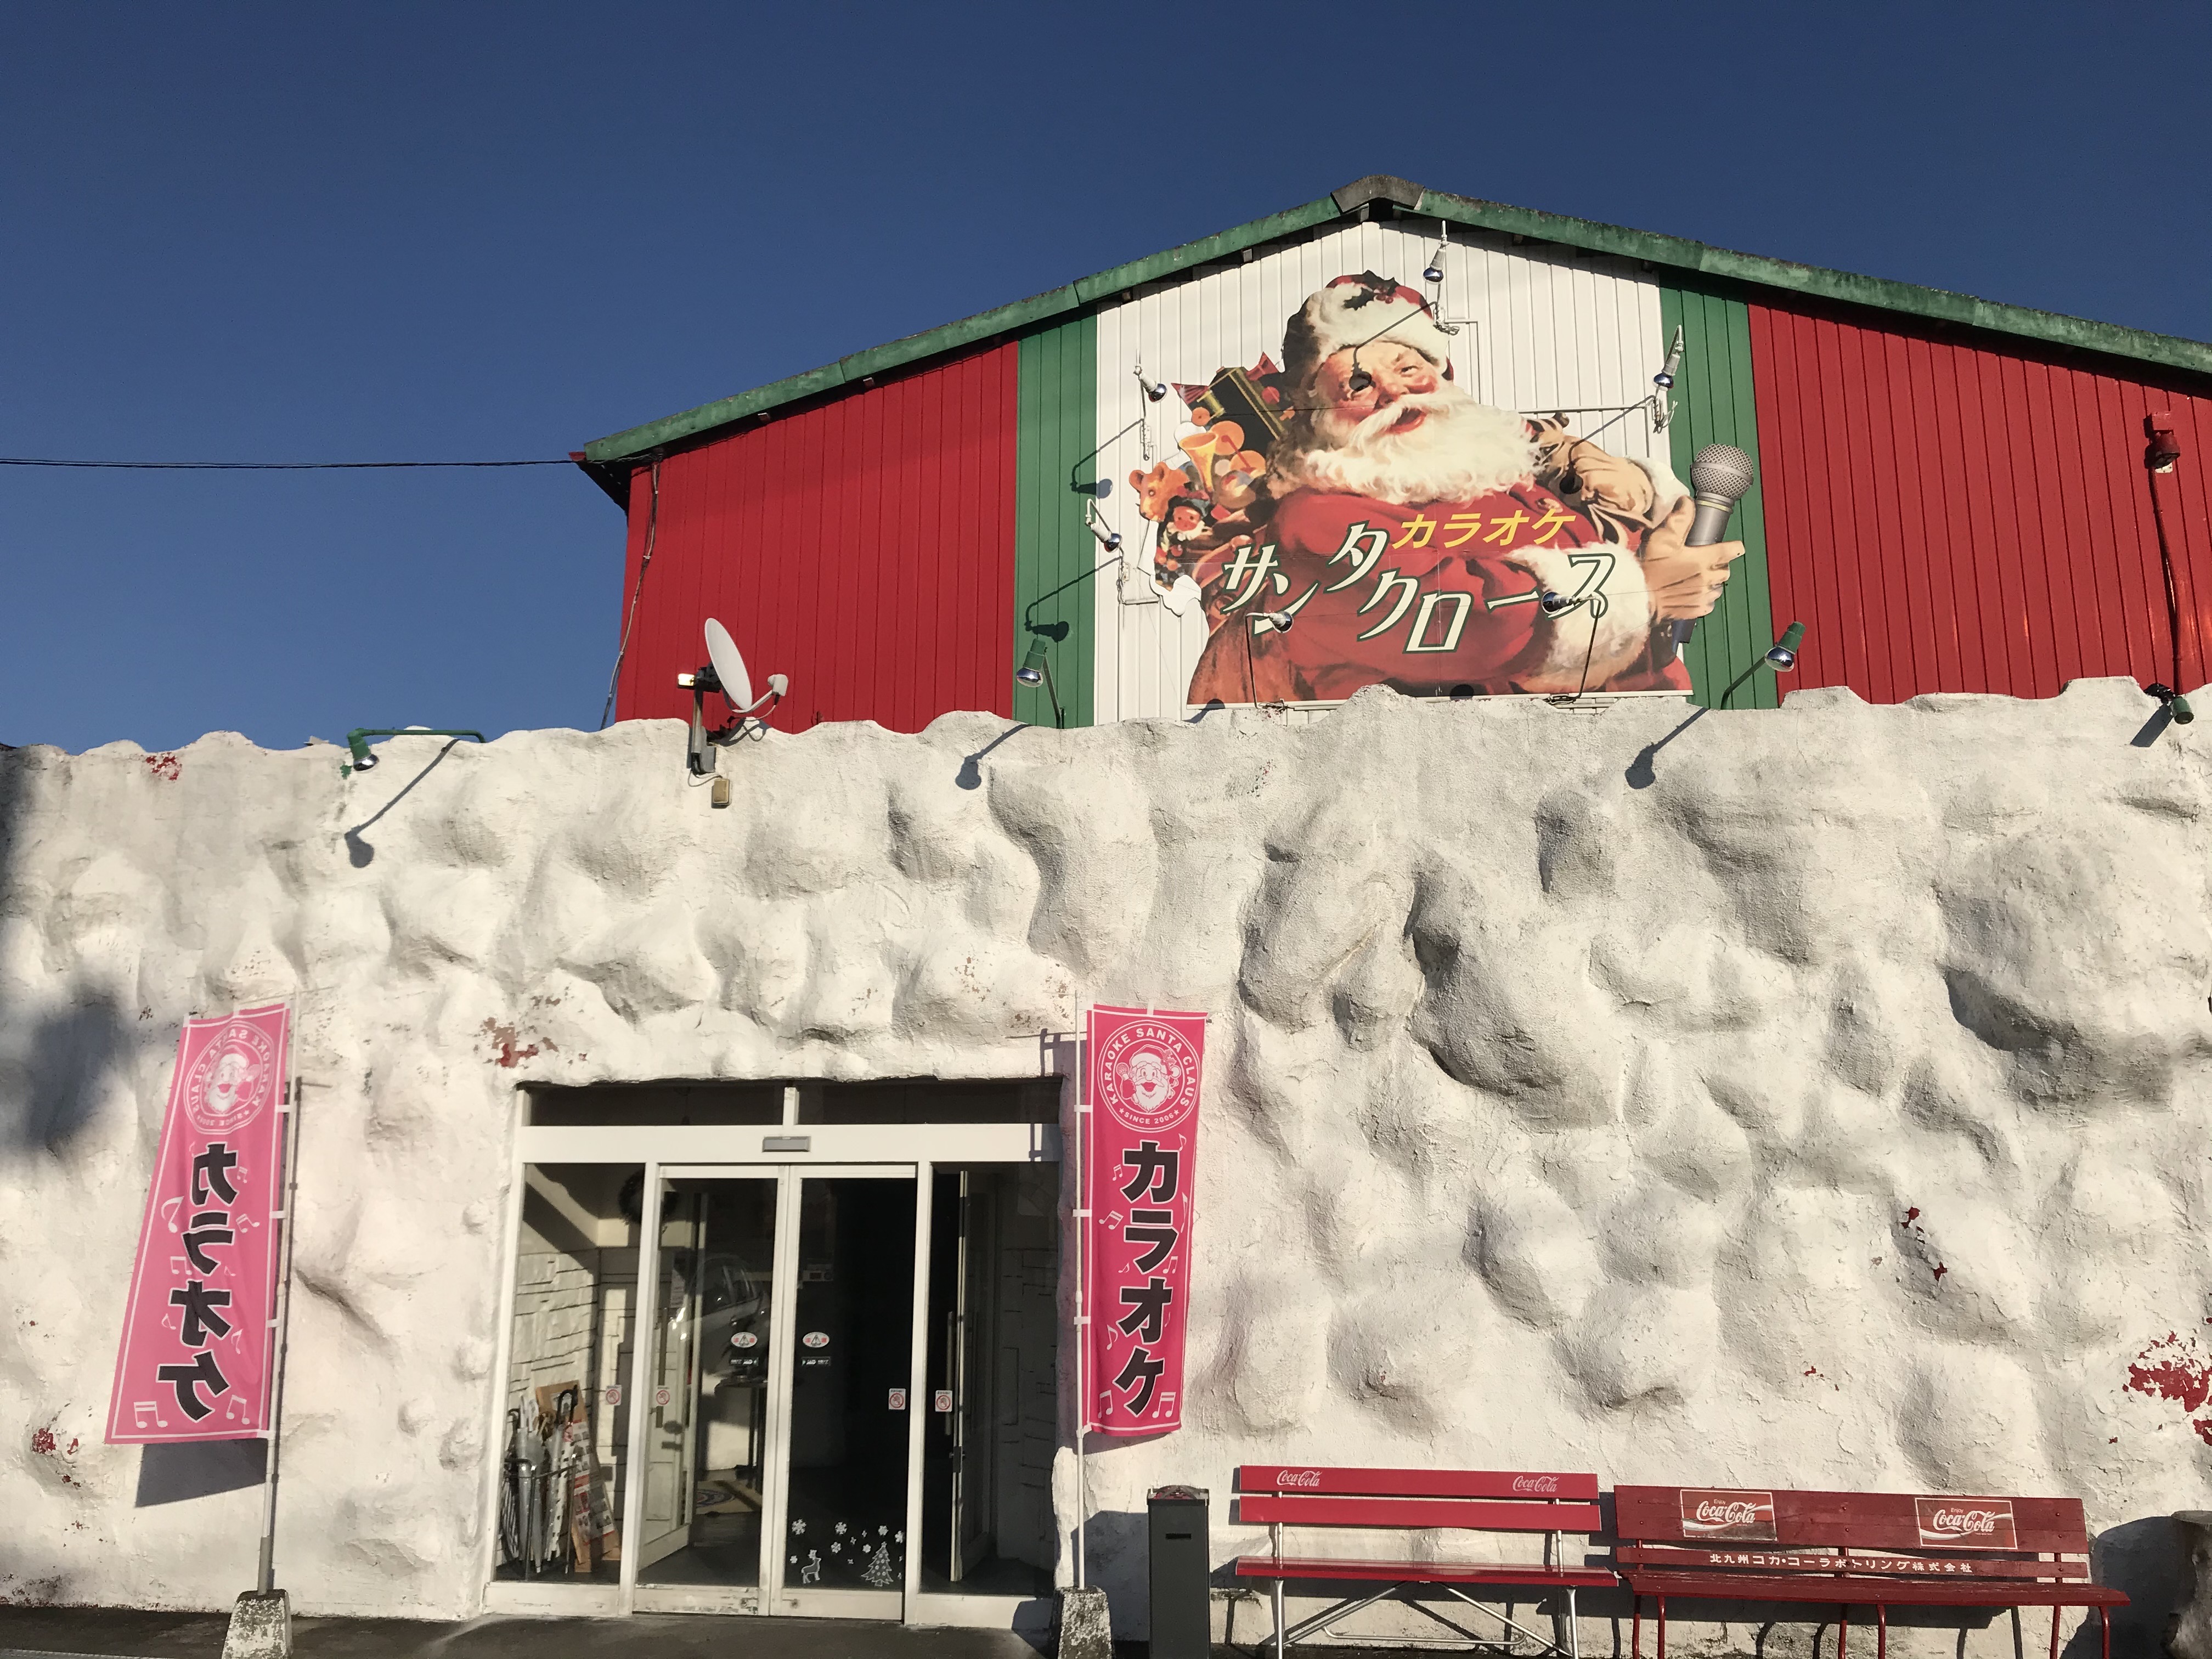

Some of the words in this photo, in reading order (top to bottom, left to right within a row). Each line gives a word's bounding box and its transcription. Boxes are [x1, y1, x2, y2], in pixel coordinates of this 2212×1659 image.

[1392, 509, 1576, 550] カラオケ
[1104, 1033, 1131, 1104] KARAOKE
[1136, 1028, 1182, 1053] SANTA
[1180, 1056, 1195, 1107] CLAUS
[1124, 1111, 1150, 1124] SINCE
[1154, 1113, 1174, 1124] 2006
[1112, 1139, 1180, 1418] カラオケ
[1277, 1470, 1323, 1487] Coca-Cola
[1513, 1475, 1560, 1492] Coca-Cola
[1696, 1500, 1757, 1523] Coca-Cola
[1933, 1509, 1996, 1532] Coca-Cola
